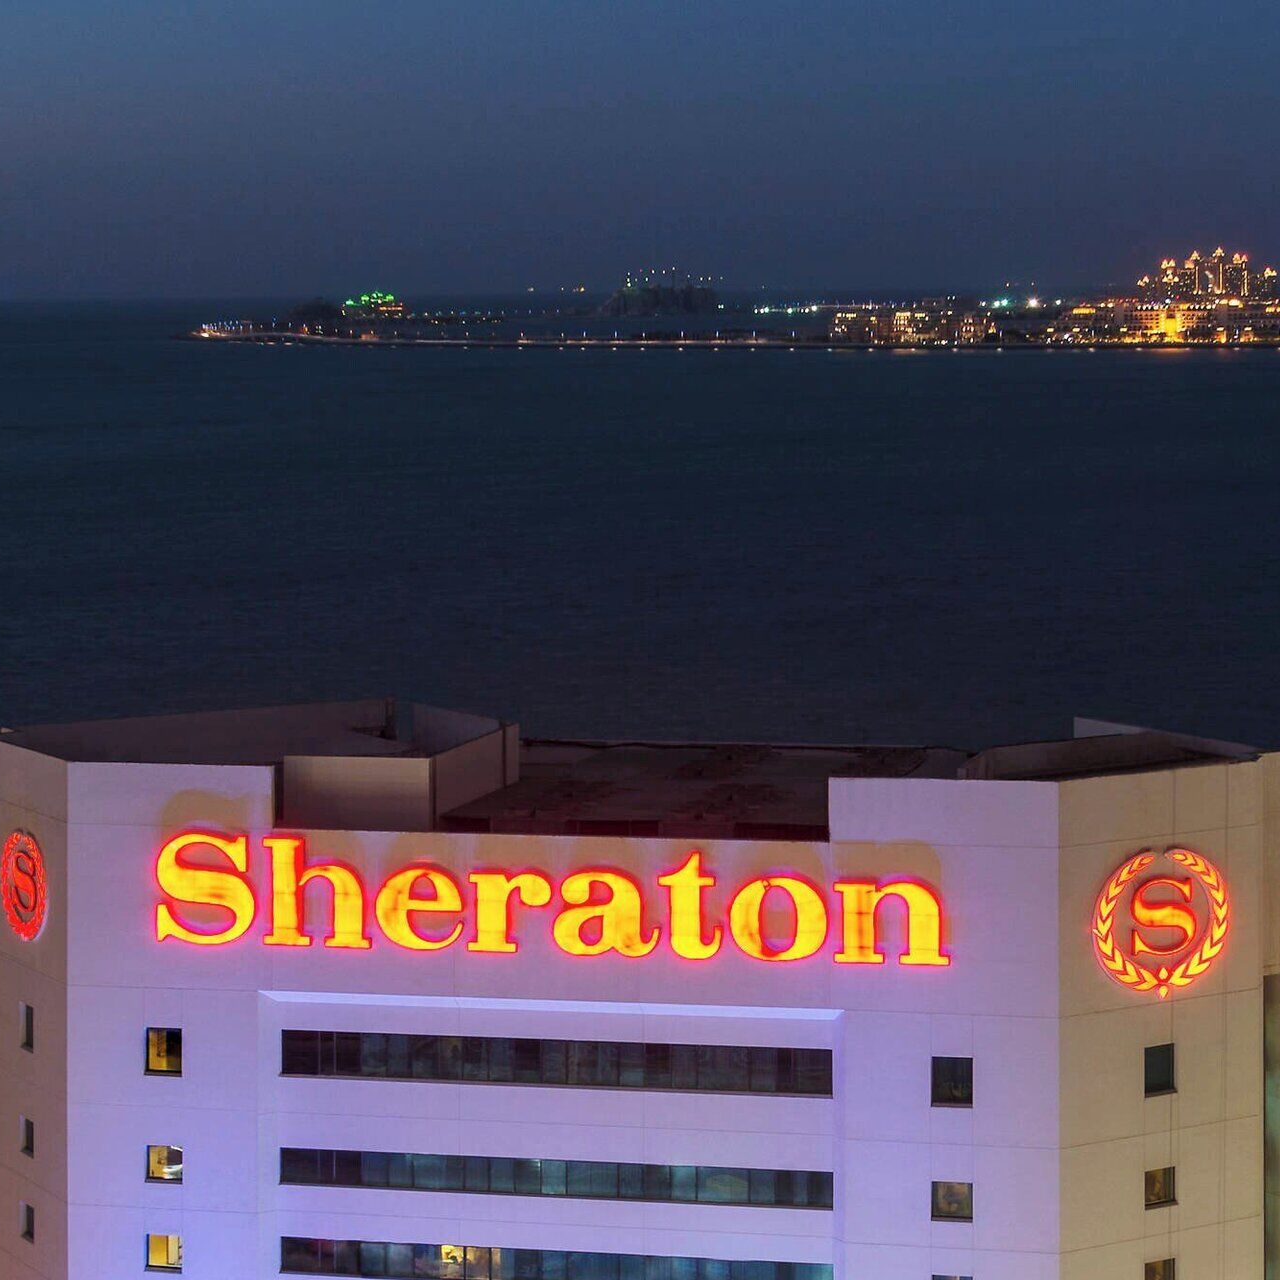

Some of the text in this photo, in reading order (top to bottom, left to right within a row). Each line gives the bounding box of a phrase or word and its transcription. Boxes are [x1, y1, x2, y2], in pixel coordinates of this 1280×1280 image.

[11, 850, 37, 912] S
[154, 829, 951, 967] Sheraton
[1130, 876, 1197, 957] S
